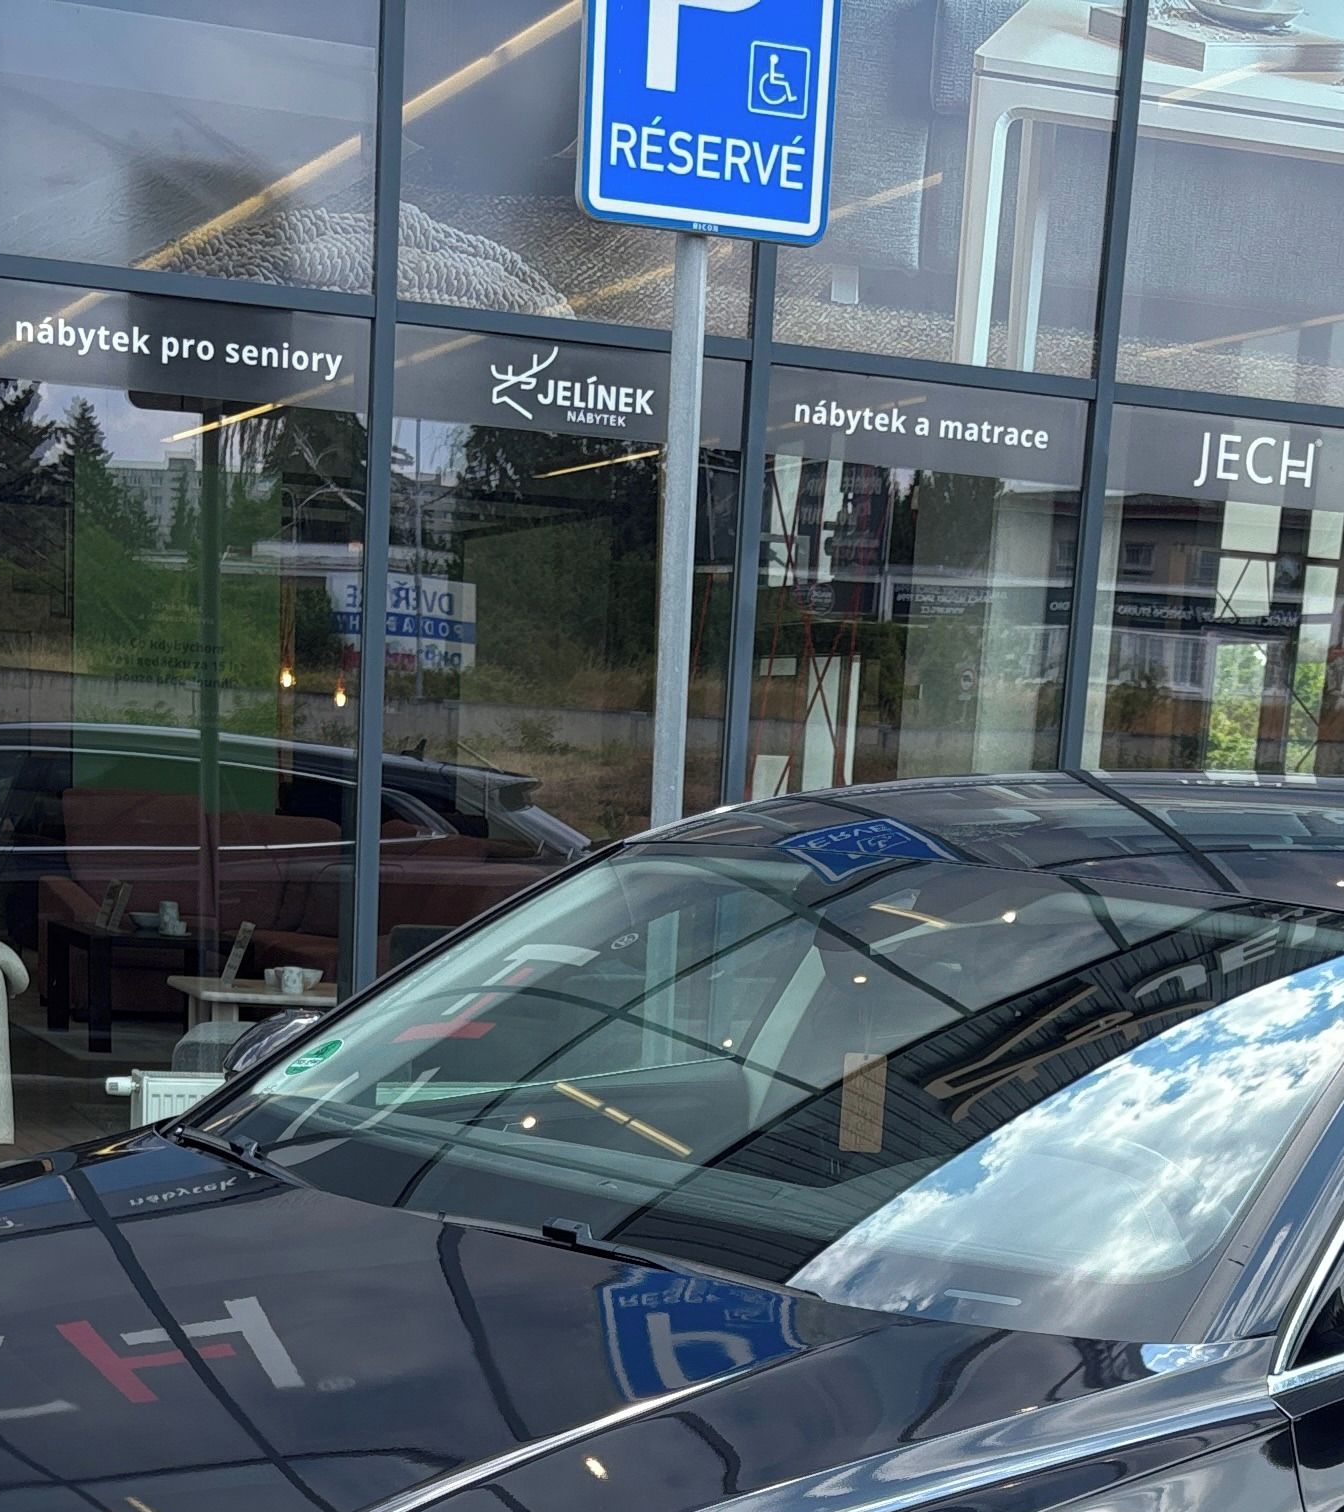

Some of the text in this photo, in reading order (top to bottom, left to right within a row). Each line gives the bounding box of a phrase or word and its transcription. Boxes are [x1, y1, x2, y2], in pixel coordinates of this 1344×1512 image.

[609, 117, 806, 191] RÉSERVÉ
[15, 316, 343, 381] nábytek pro seniory
[537, 374, 655, 416] JELÍNEK
[566, 408, 627, 428] NÁBYTEK
[794, 400, 1050, 449] nábytek a matrace
[1193, 430, 1315, 489] JECH
